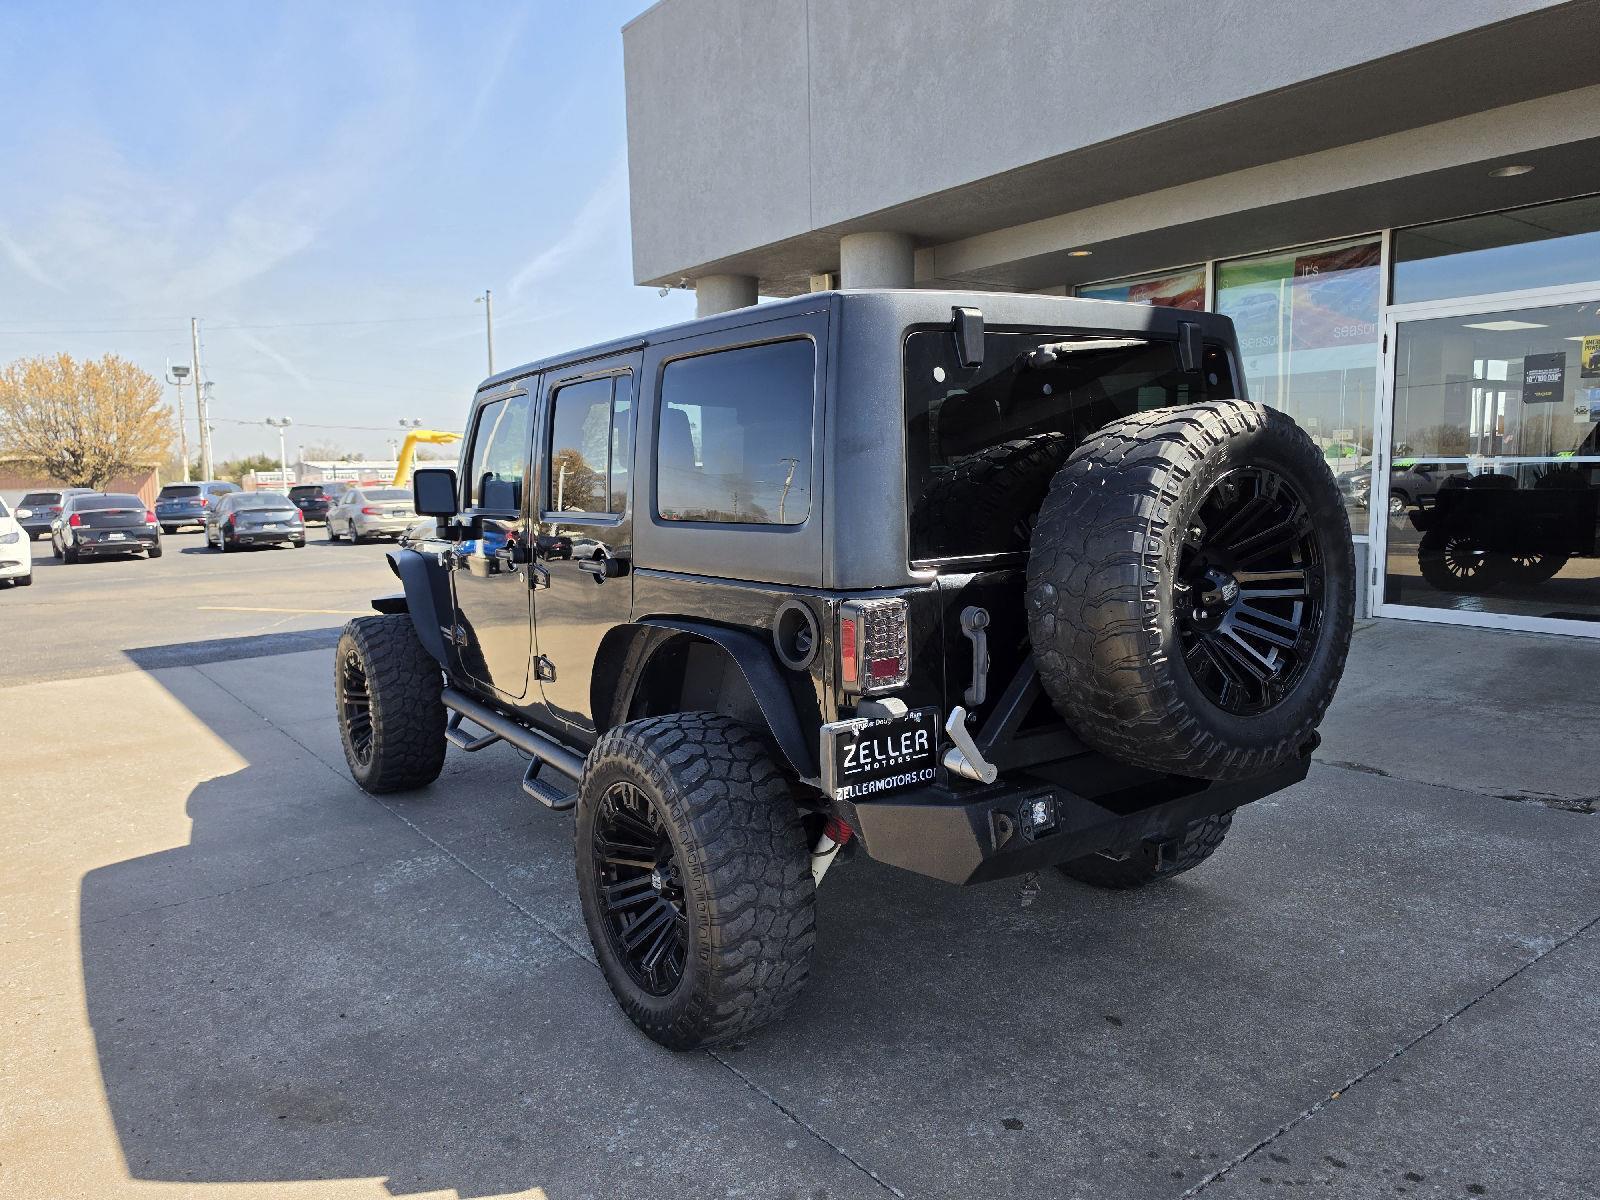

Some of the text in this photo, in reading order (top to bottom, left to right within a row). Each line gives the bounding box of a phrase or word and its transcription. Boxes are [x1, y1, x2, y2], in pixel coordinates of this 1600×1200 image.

[1301, 264, 1319, 278] It's
[843, 729, 929, 768] ZELLER
[864, 754, 911, 772] MOTORS
